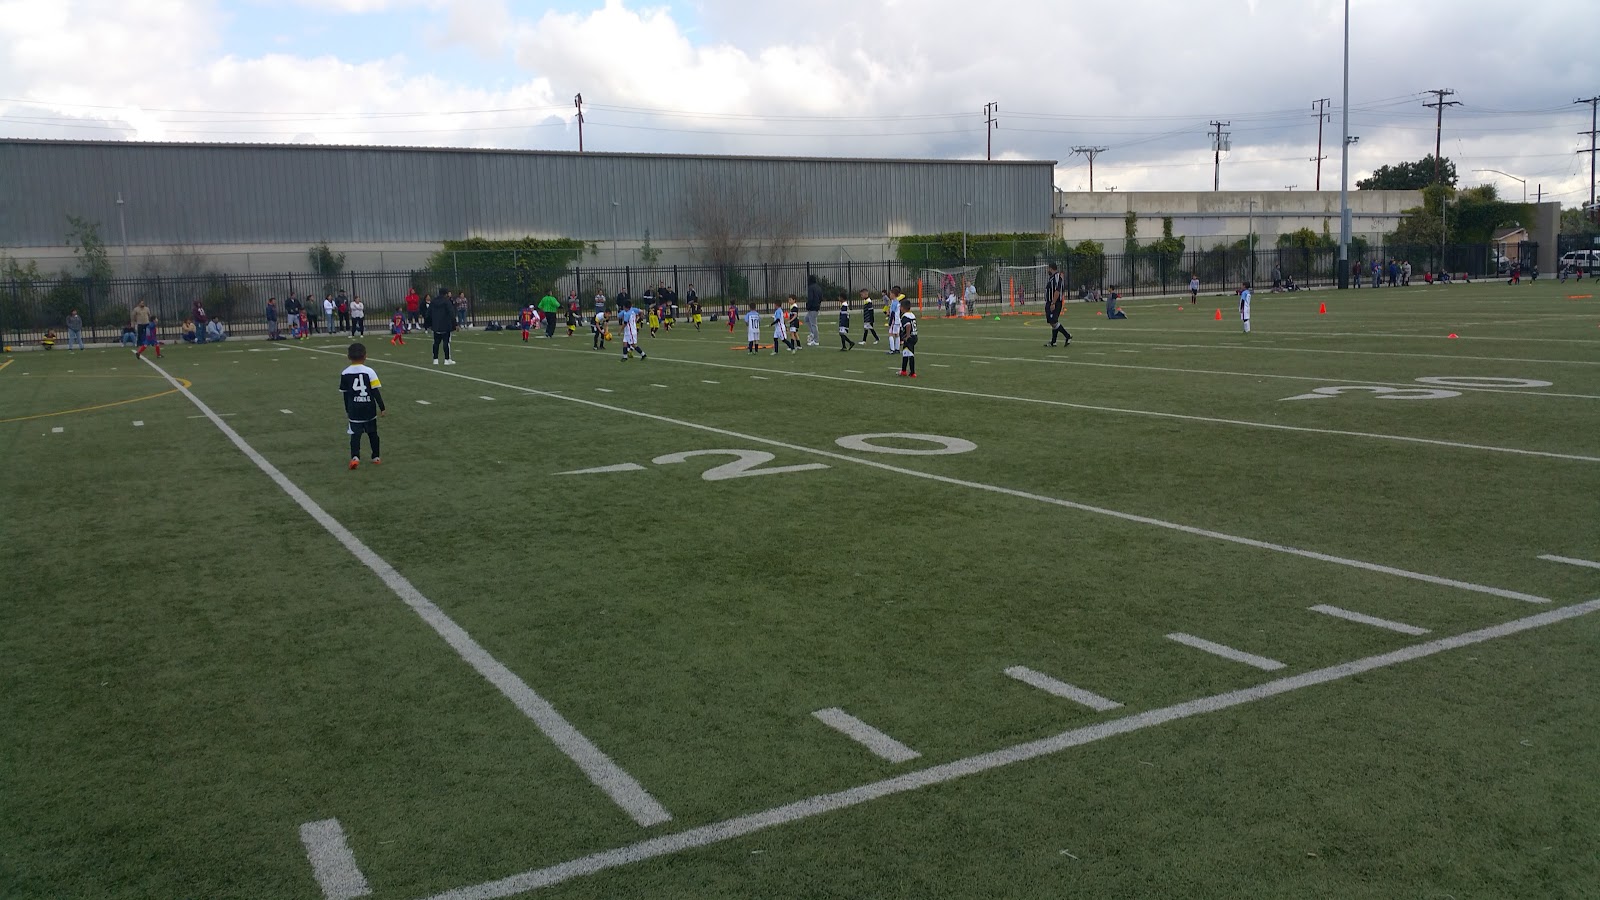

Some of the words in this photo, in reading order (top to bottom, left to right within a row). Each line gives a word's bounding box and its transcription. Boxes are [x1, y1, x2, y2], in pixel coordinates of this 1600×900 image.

[751, 318, 759, 329] 10
[352, 373, 368, 396] 4
[1312, 376, 1554, 400] 30
[651, 432, 978, 481] 20
